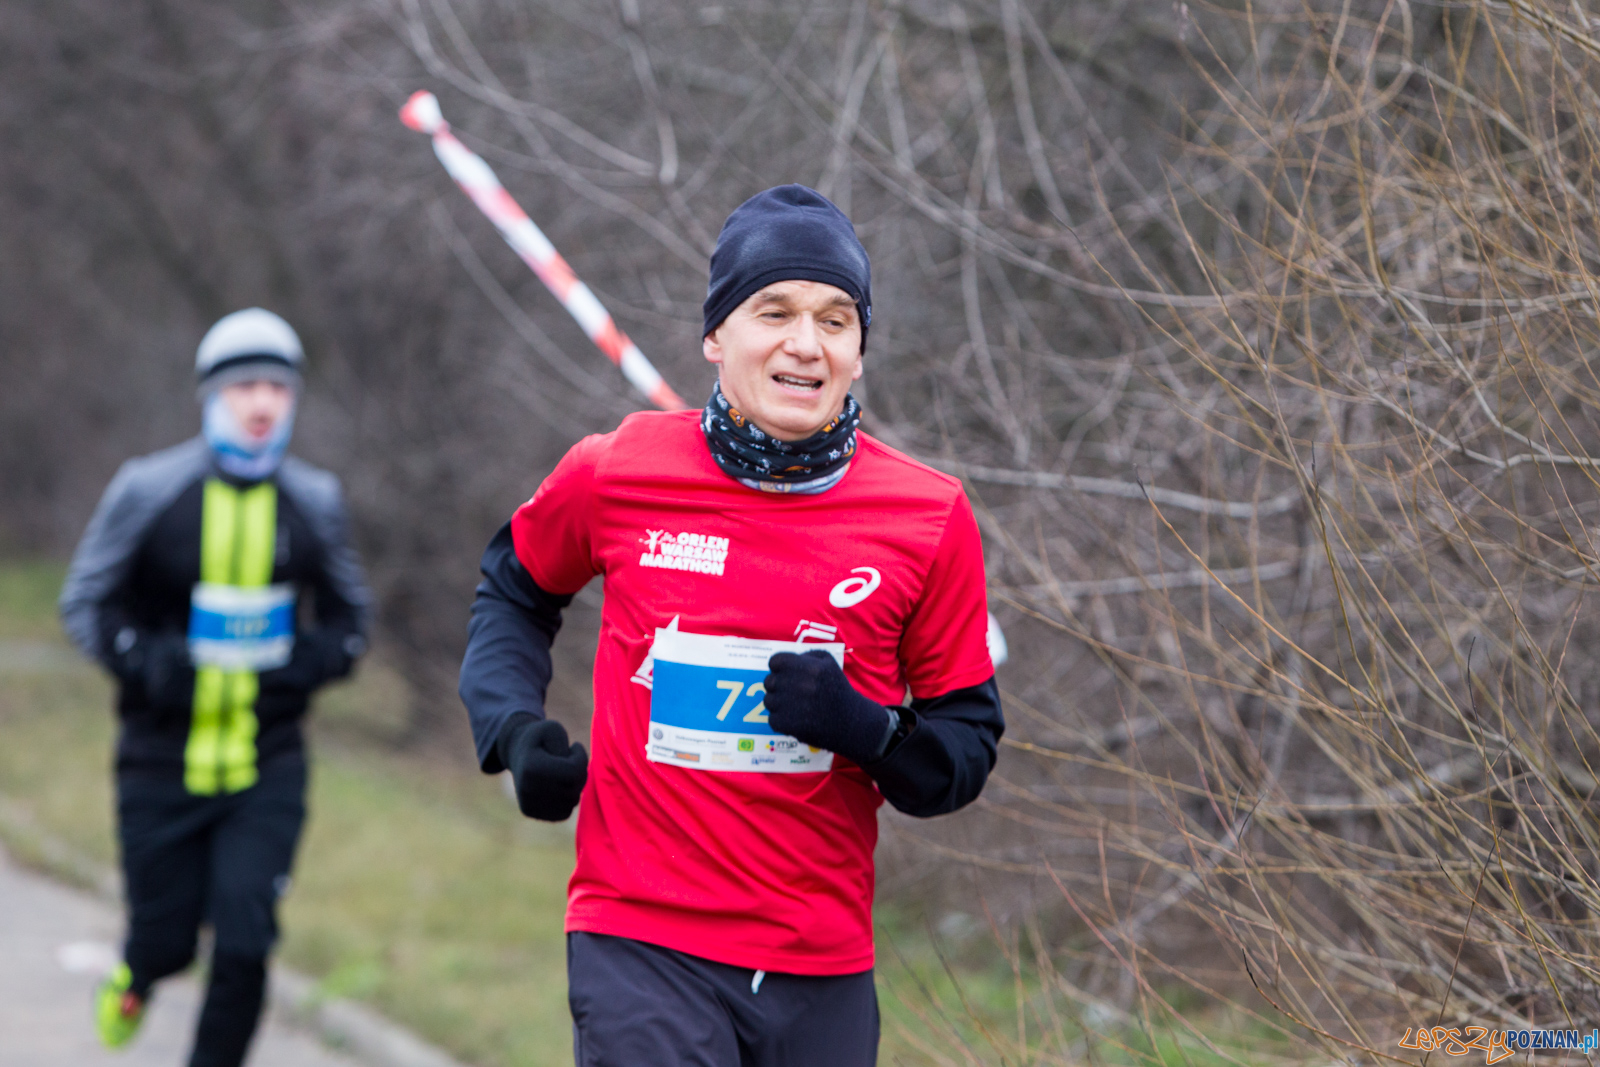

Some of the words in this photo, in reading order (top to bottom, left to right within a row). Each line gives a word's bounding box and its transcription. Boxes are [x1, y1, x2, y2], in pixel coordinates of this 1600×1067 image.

[677, 532, 730, 550] ORLEN
[661, 543, 728, 562] WARSAW
[639, 553, 725, 576] MARATHON
